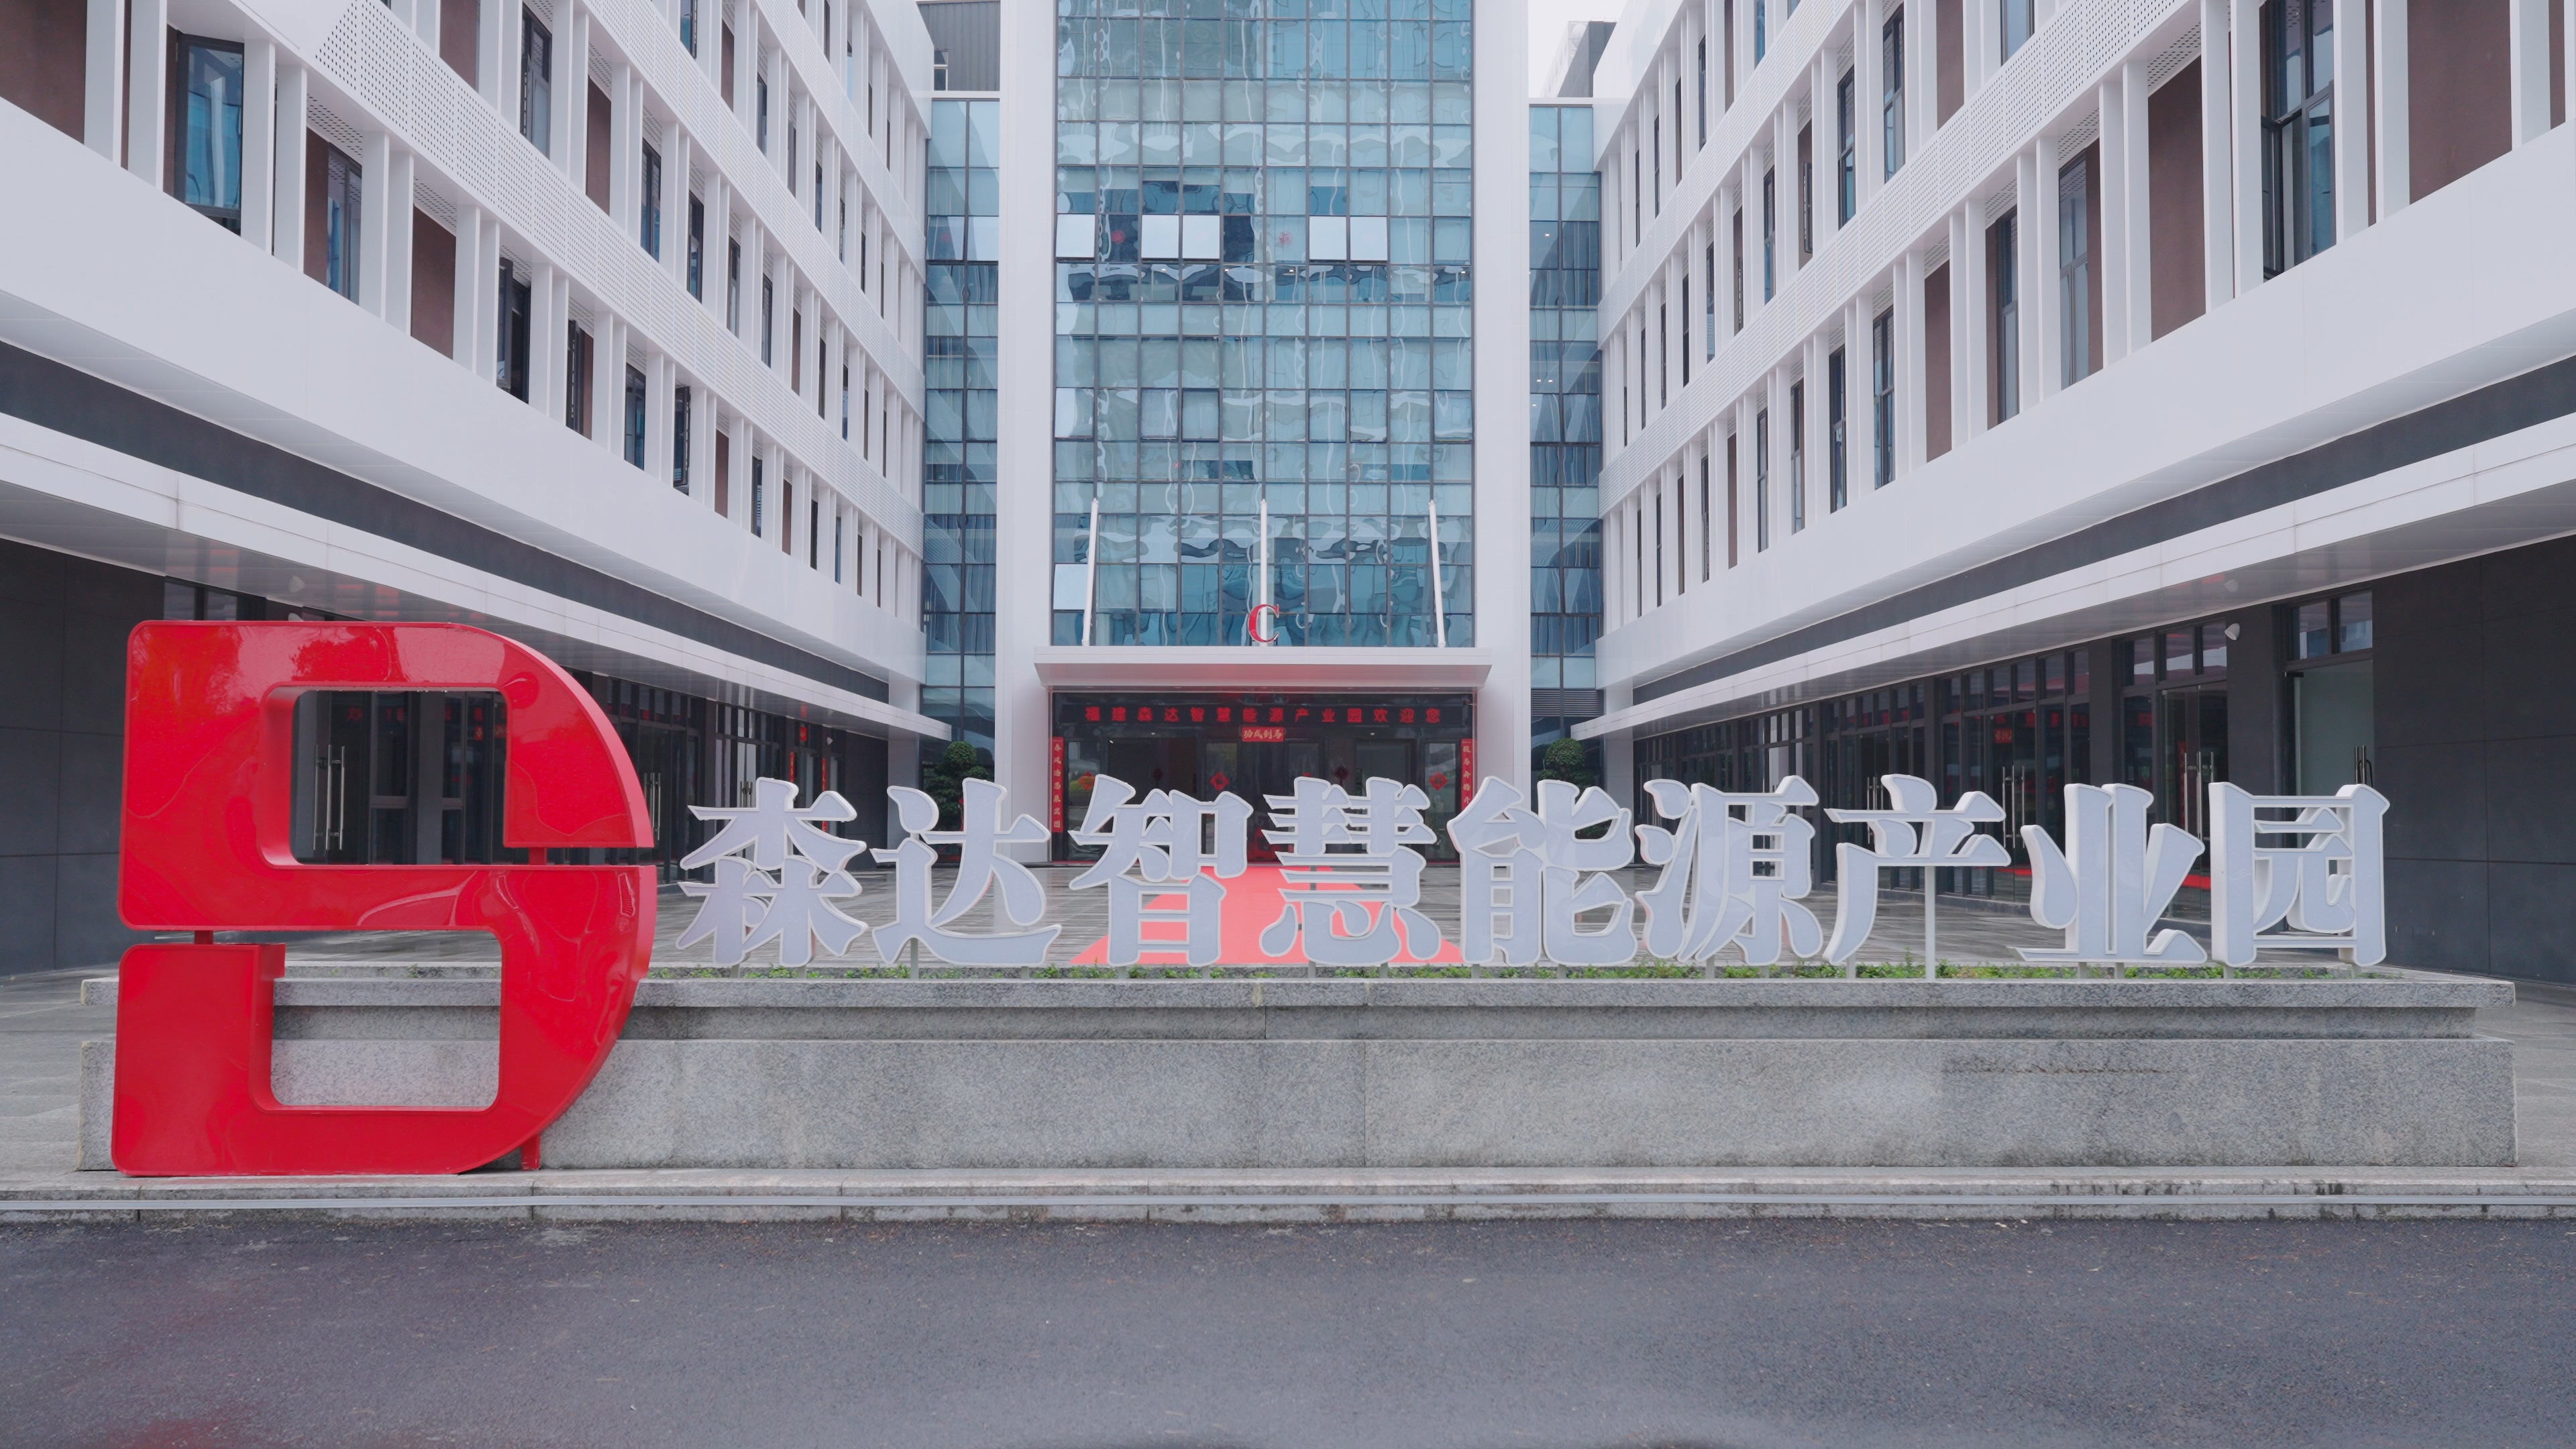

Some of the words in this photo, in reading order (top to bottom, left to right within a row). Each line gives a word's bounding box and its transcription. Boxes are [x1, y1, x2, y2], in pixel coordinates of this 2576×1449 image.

[1085, 706, 1441, 724] 福建森达智慧能源产业园欢迎您
[676, 773, 2390, 967] 森达智慧能源产业园
